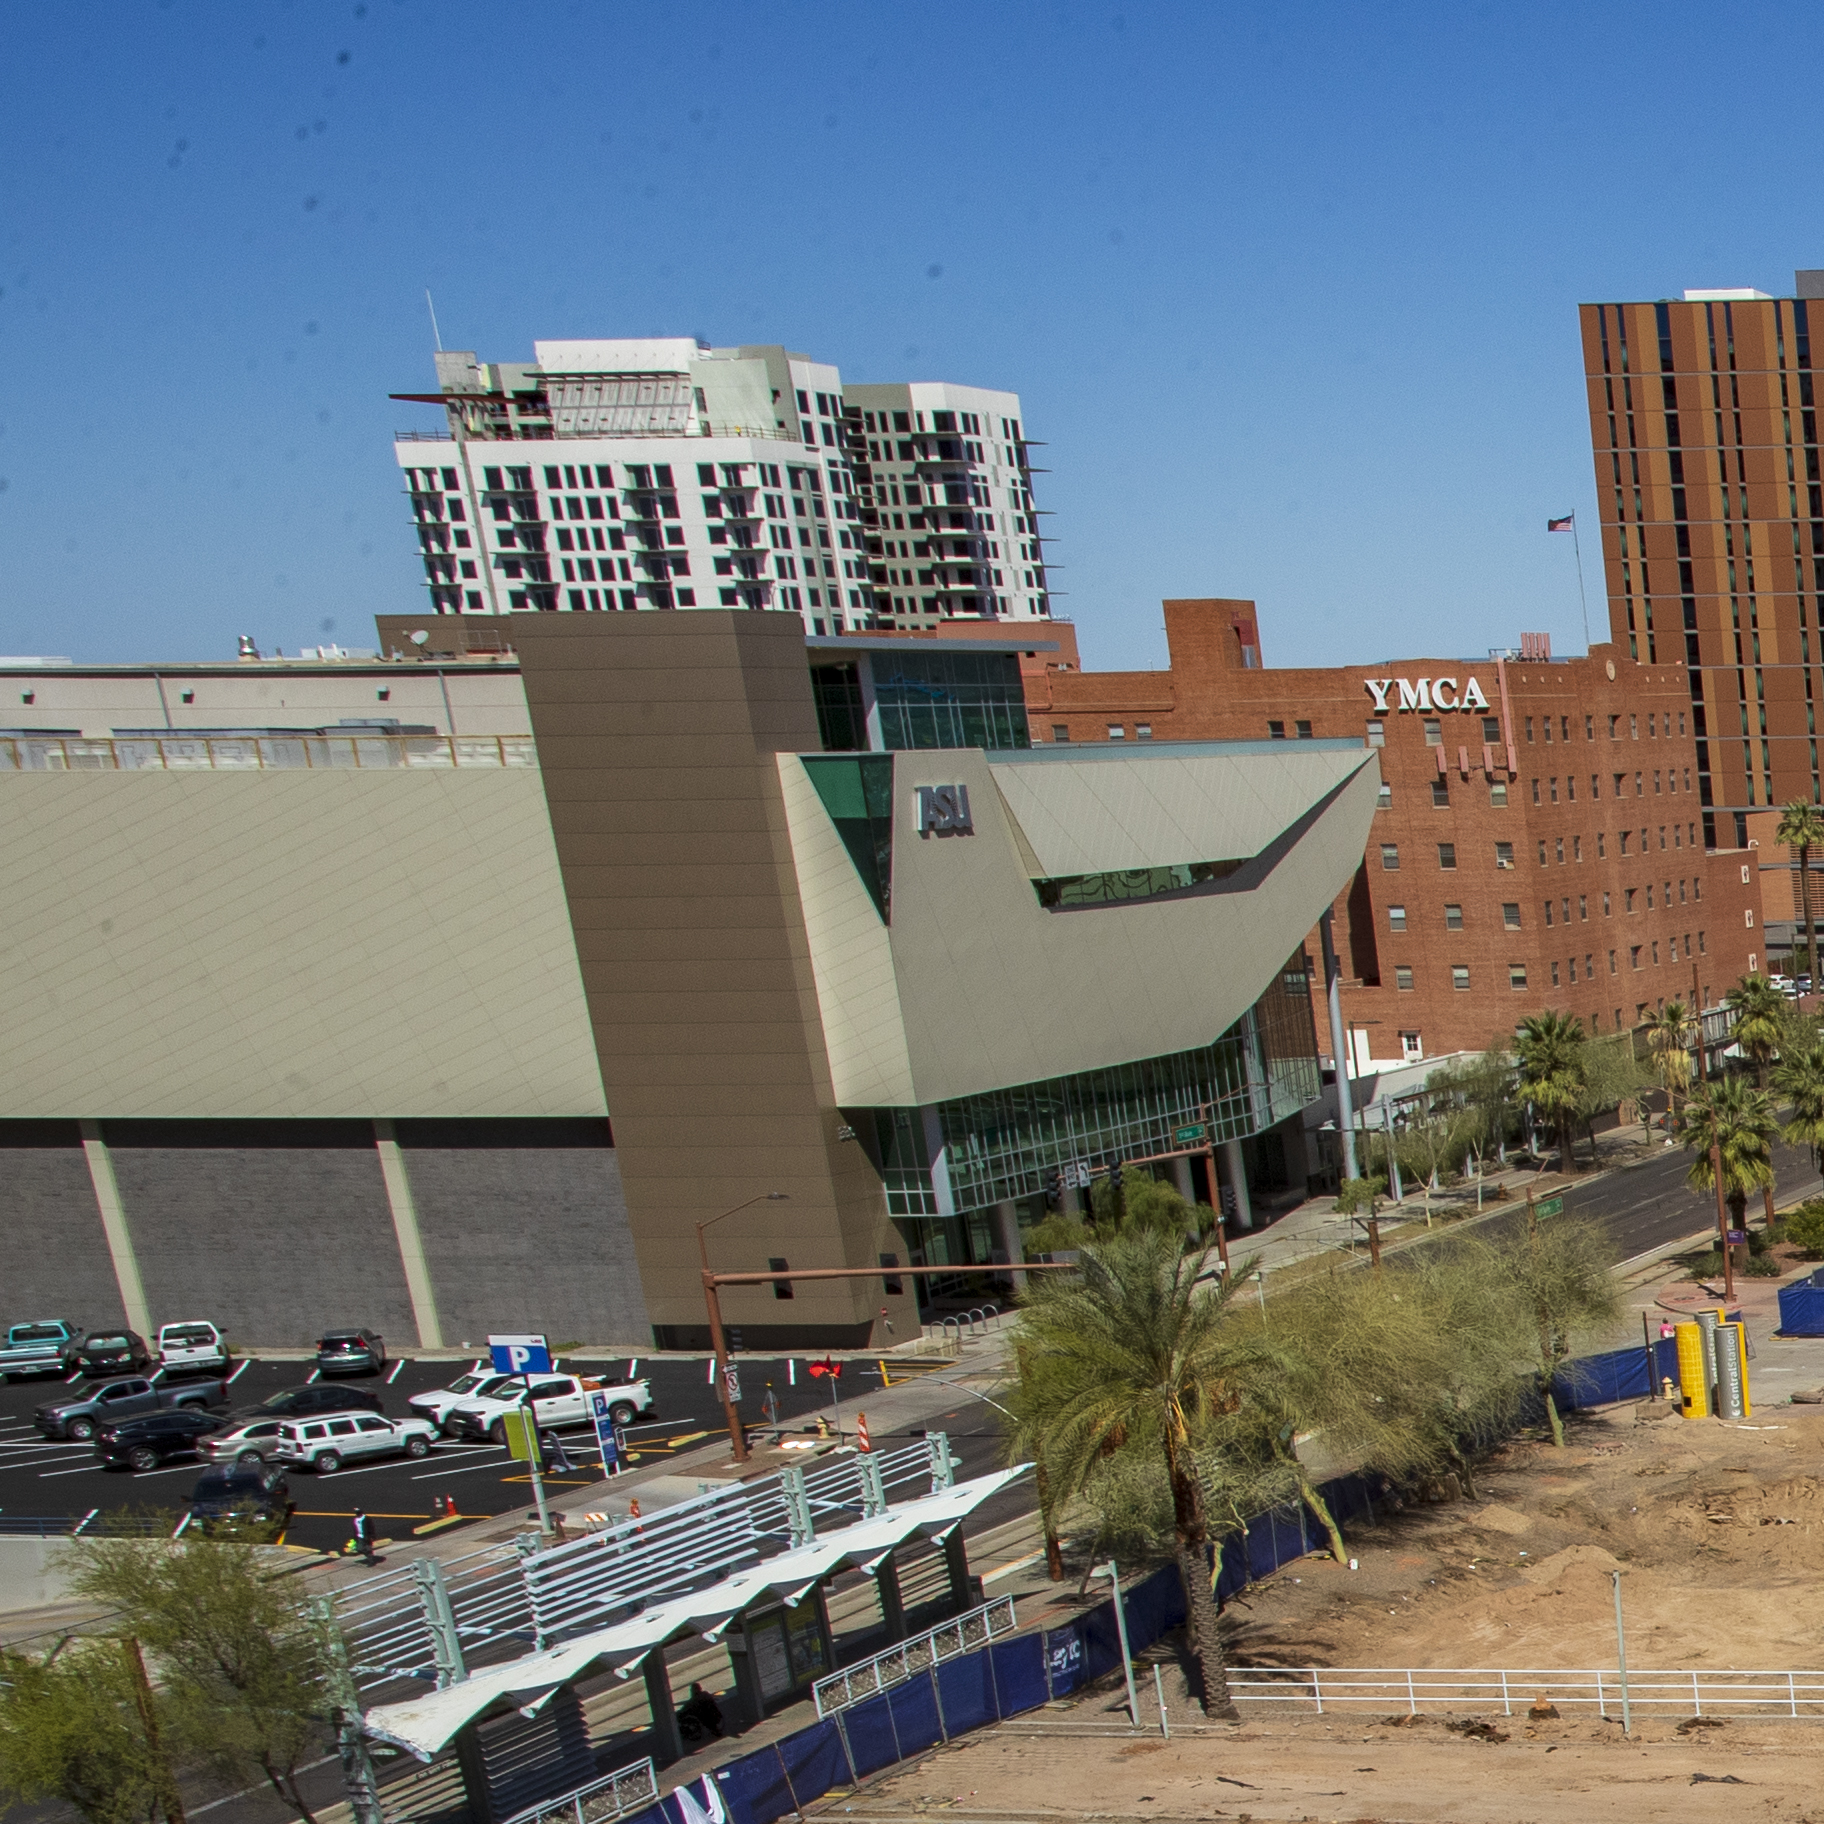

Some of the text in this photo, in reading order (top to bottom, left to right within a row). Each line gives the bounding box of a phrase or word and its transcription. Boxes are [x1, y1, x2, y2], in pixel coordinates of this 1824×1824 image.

[1364, 677, 1490, 712] YMCA
[914, 784, 974, 831] ASU
[509, 1346, 530, 1371] P
